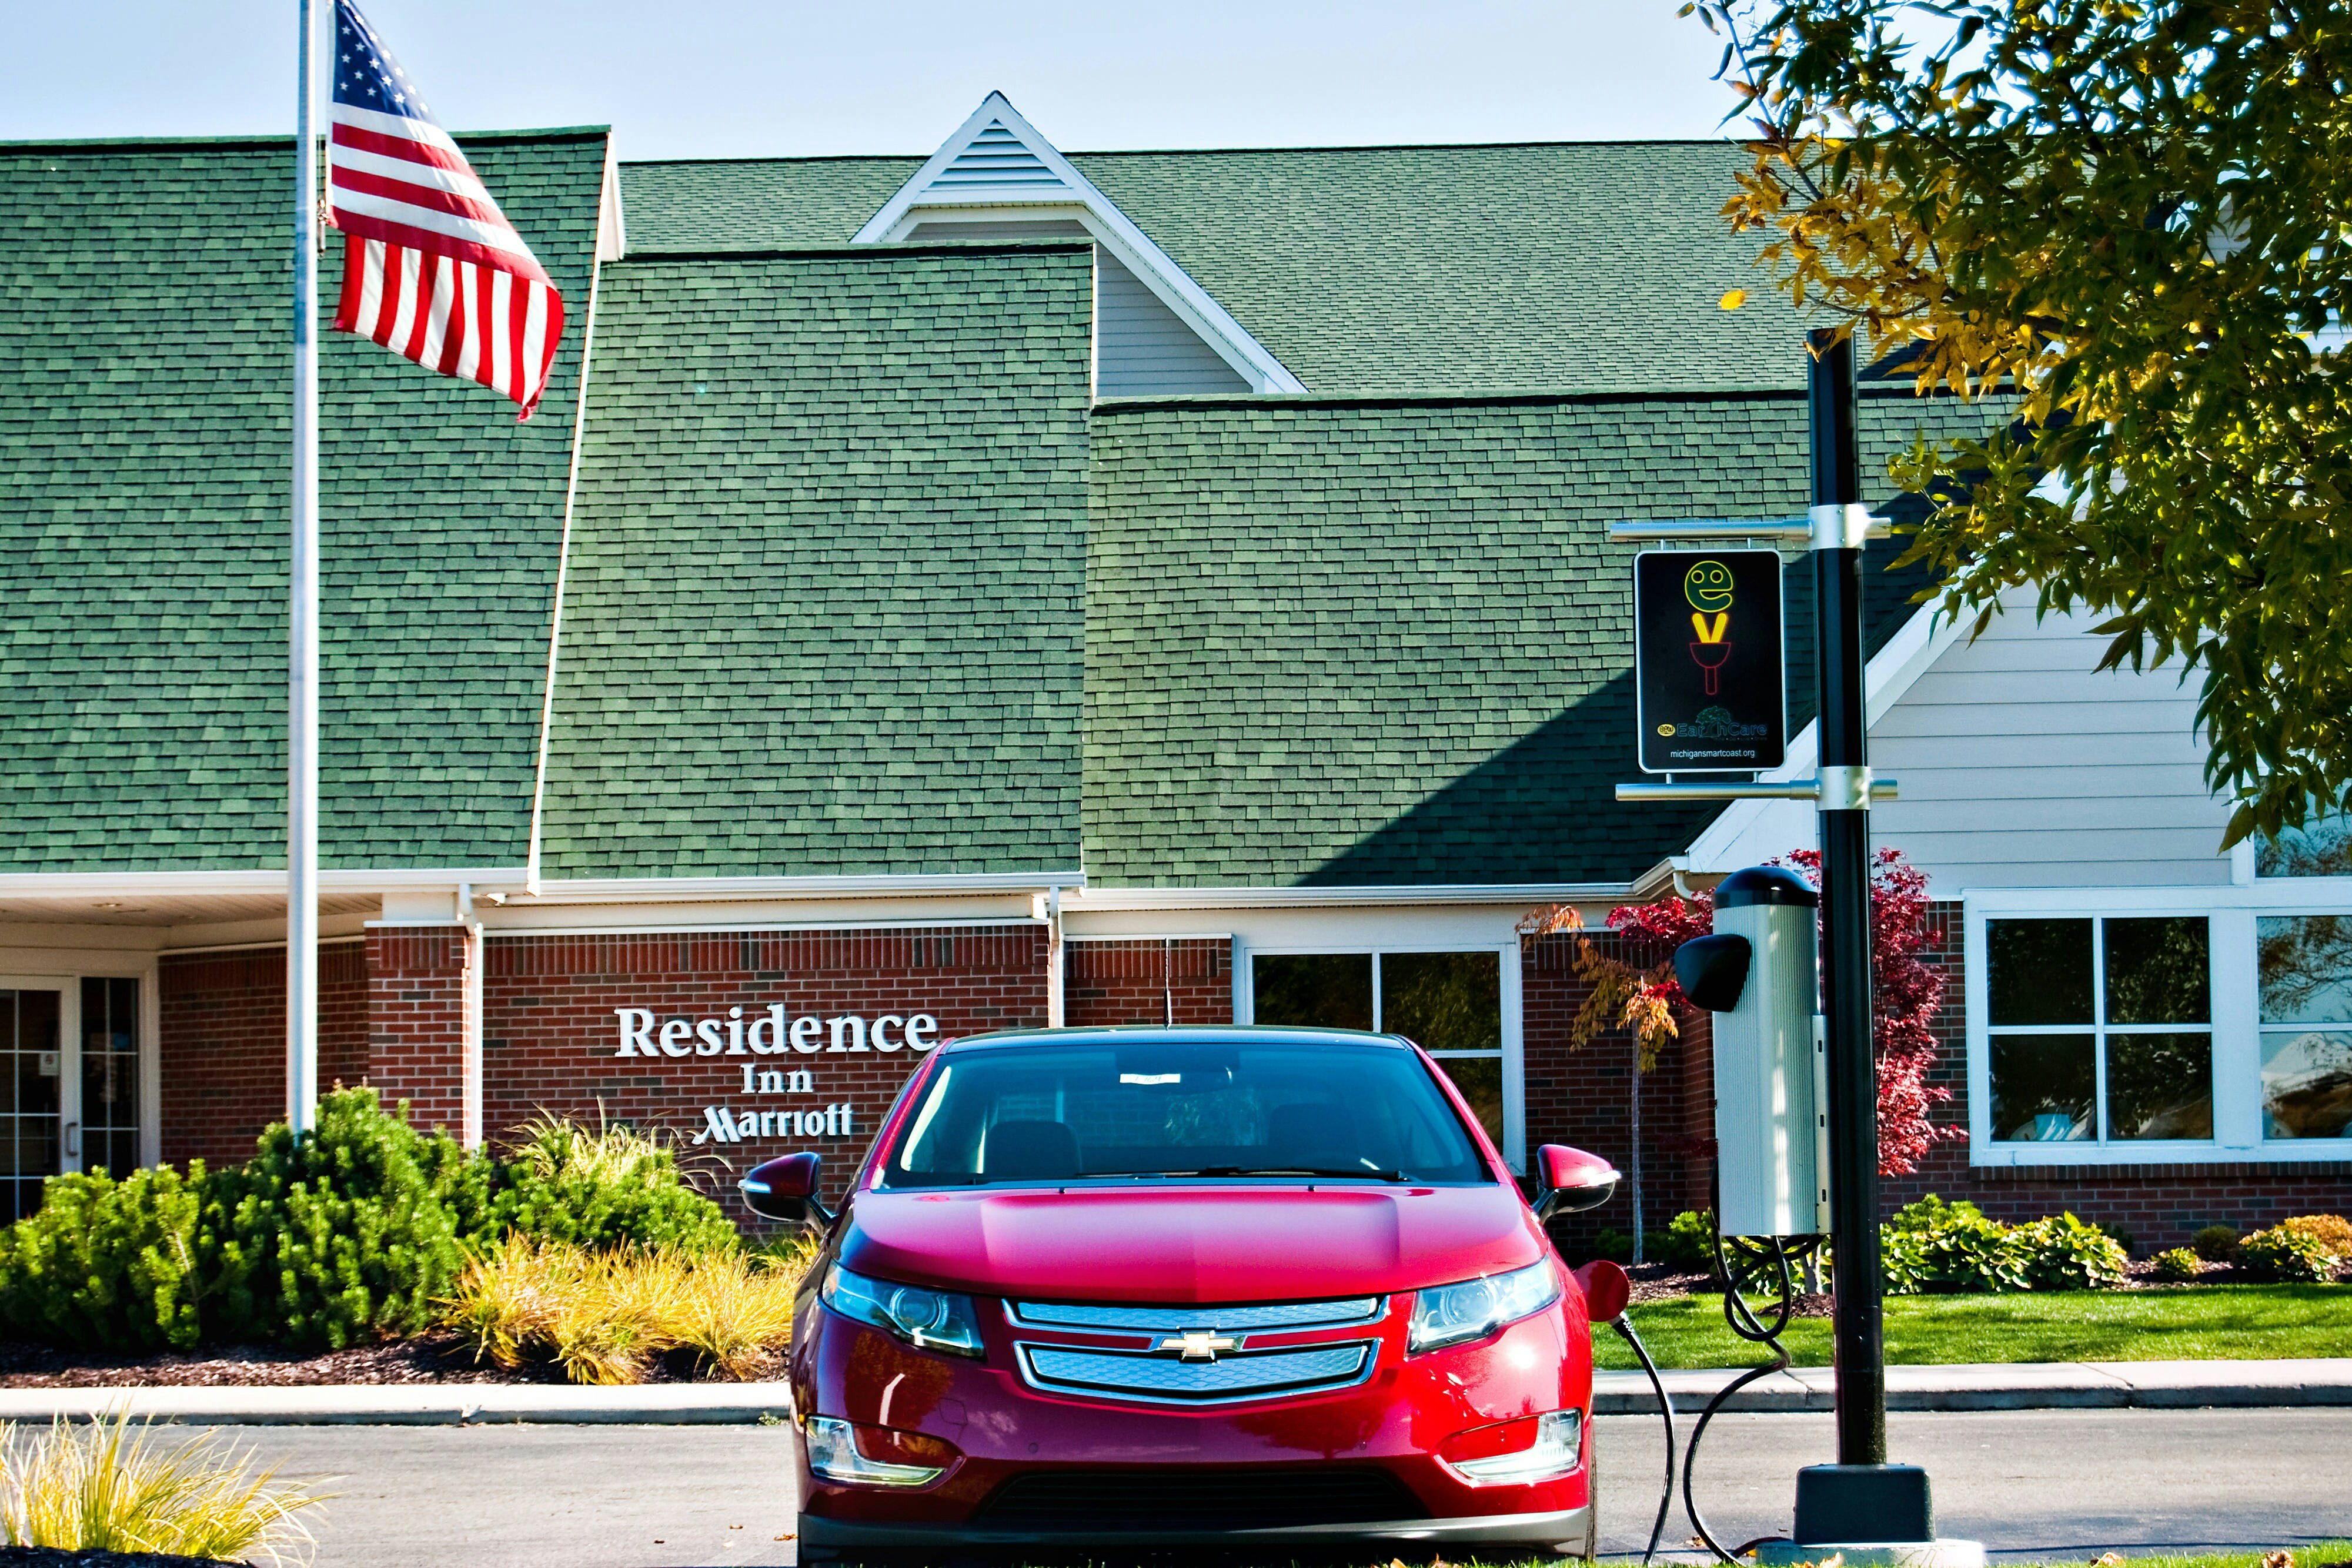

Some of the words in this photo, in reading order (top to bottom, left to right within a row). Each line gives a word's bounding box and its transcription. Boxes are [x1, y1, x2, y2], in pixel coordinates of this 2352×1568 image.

[1671, 750, 1755, 759] michigansmartcoast.org
[614, 1002, 938, 1058] Residence
[740, 1063, 813, 1094] Inn
[692, 1103, 852, 1145] Marriott
